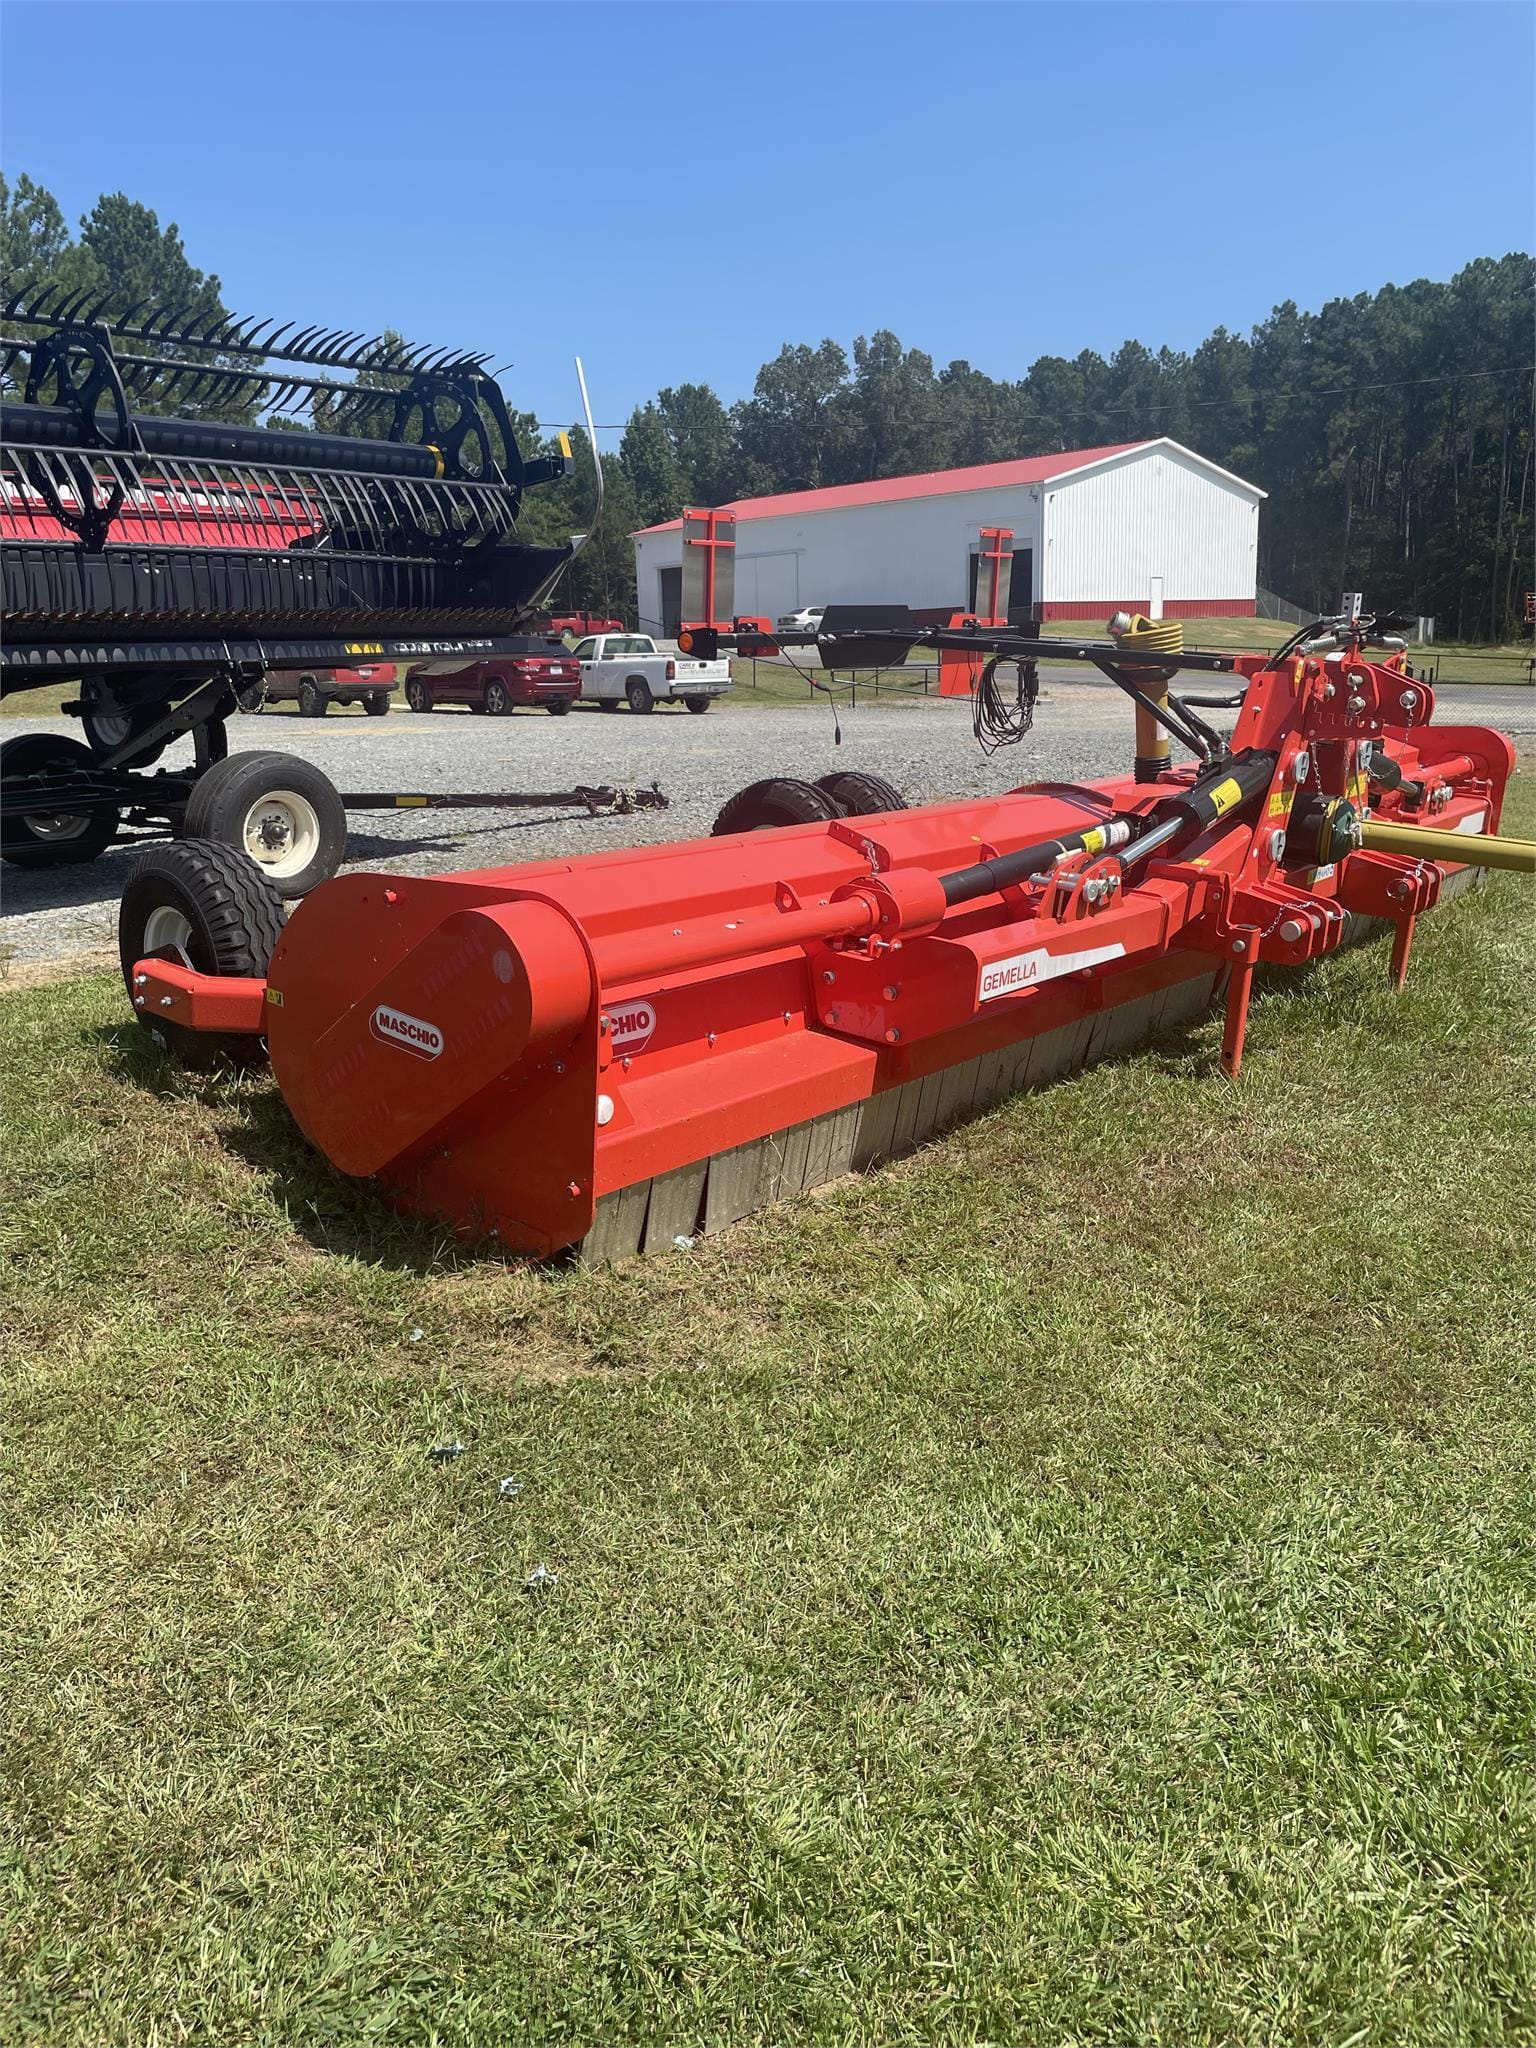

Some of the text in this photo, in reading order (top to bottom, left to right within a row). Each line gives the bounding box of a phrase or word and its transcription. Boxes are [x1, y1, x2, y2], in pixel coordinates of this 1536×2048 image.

[983, 961, 1037, 993] GEMELLA
[379, 1012, 440, 1049] MASCHIO
[610, 1010, 650, 1038] CHIO
